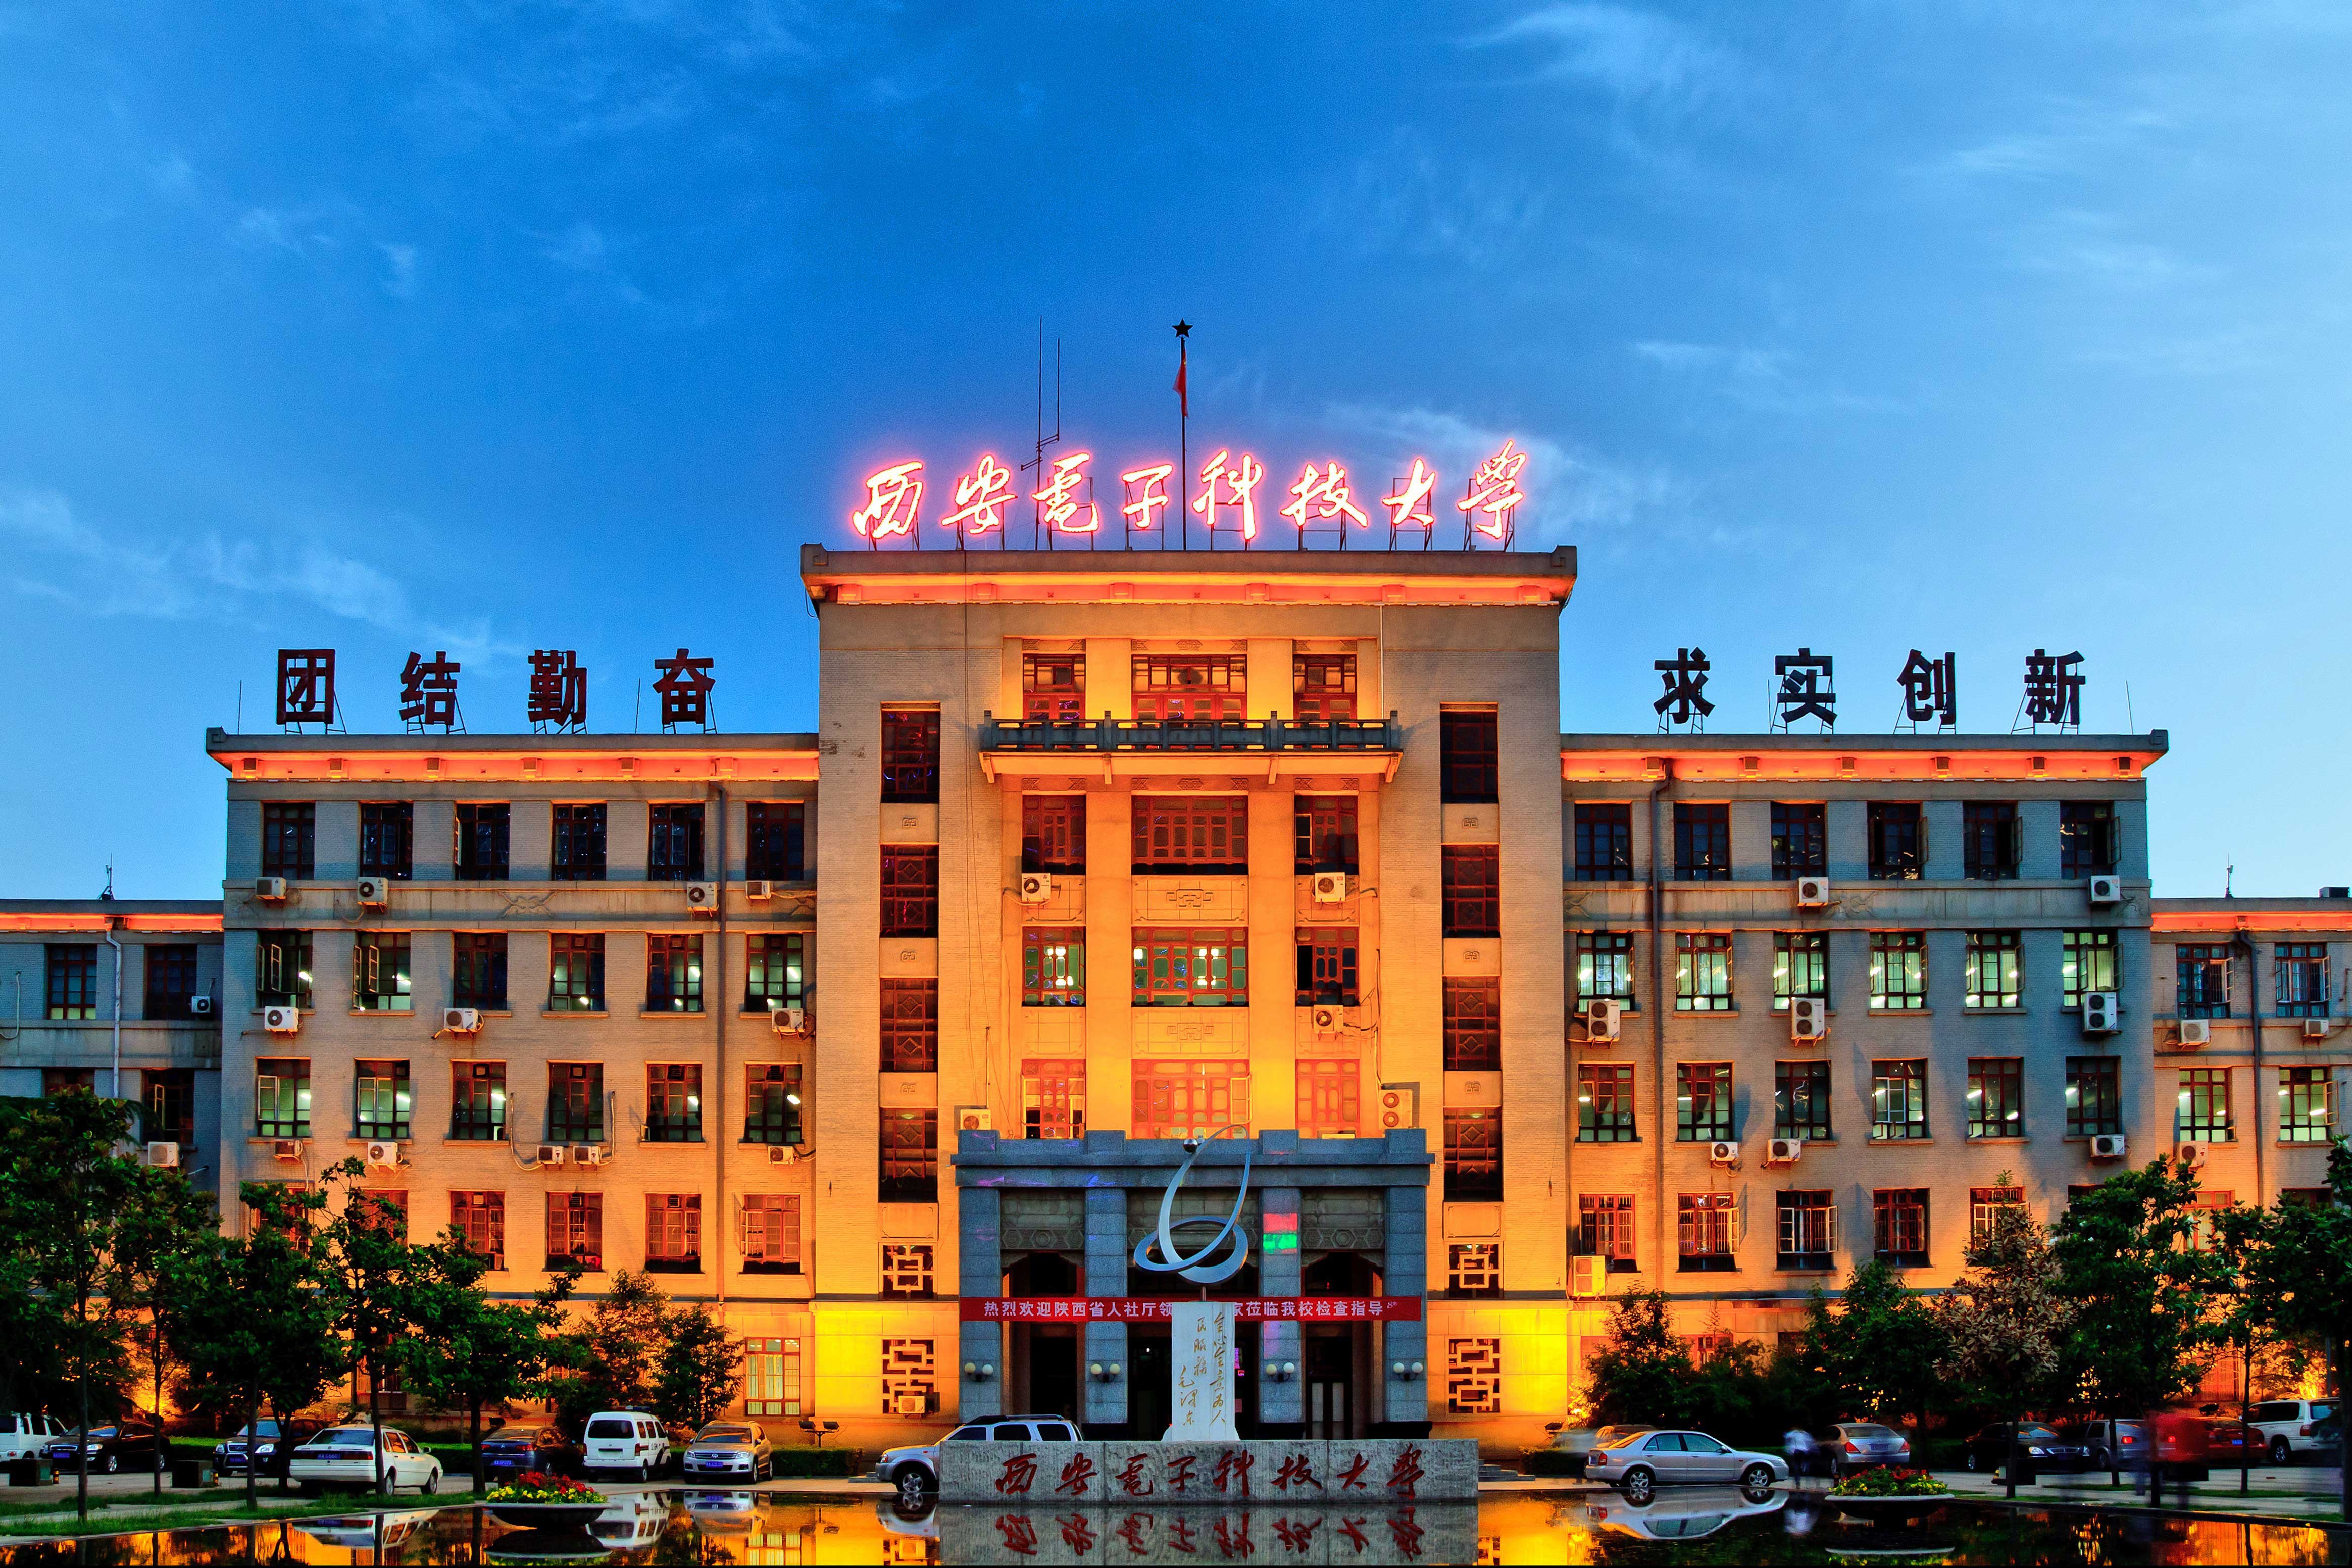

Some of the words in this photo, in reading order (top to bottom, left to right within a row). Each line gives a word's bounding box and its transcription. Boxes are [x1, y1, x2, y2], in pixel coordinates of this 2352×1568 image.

[276, 648, 716, 725] 团结勤奋
[1653, 647, 2086, 725] 求实创新
